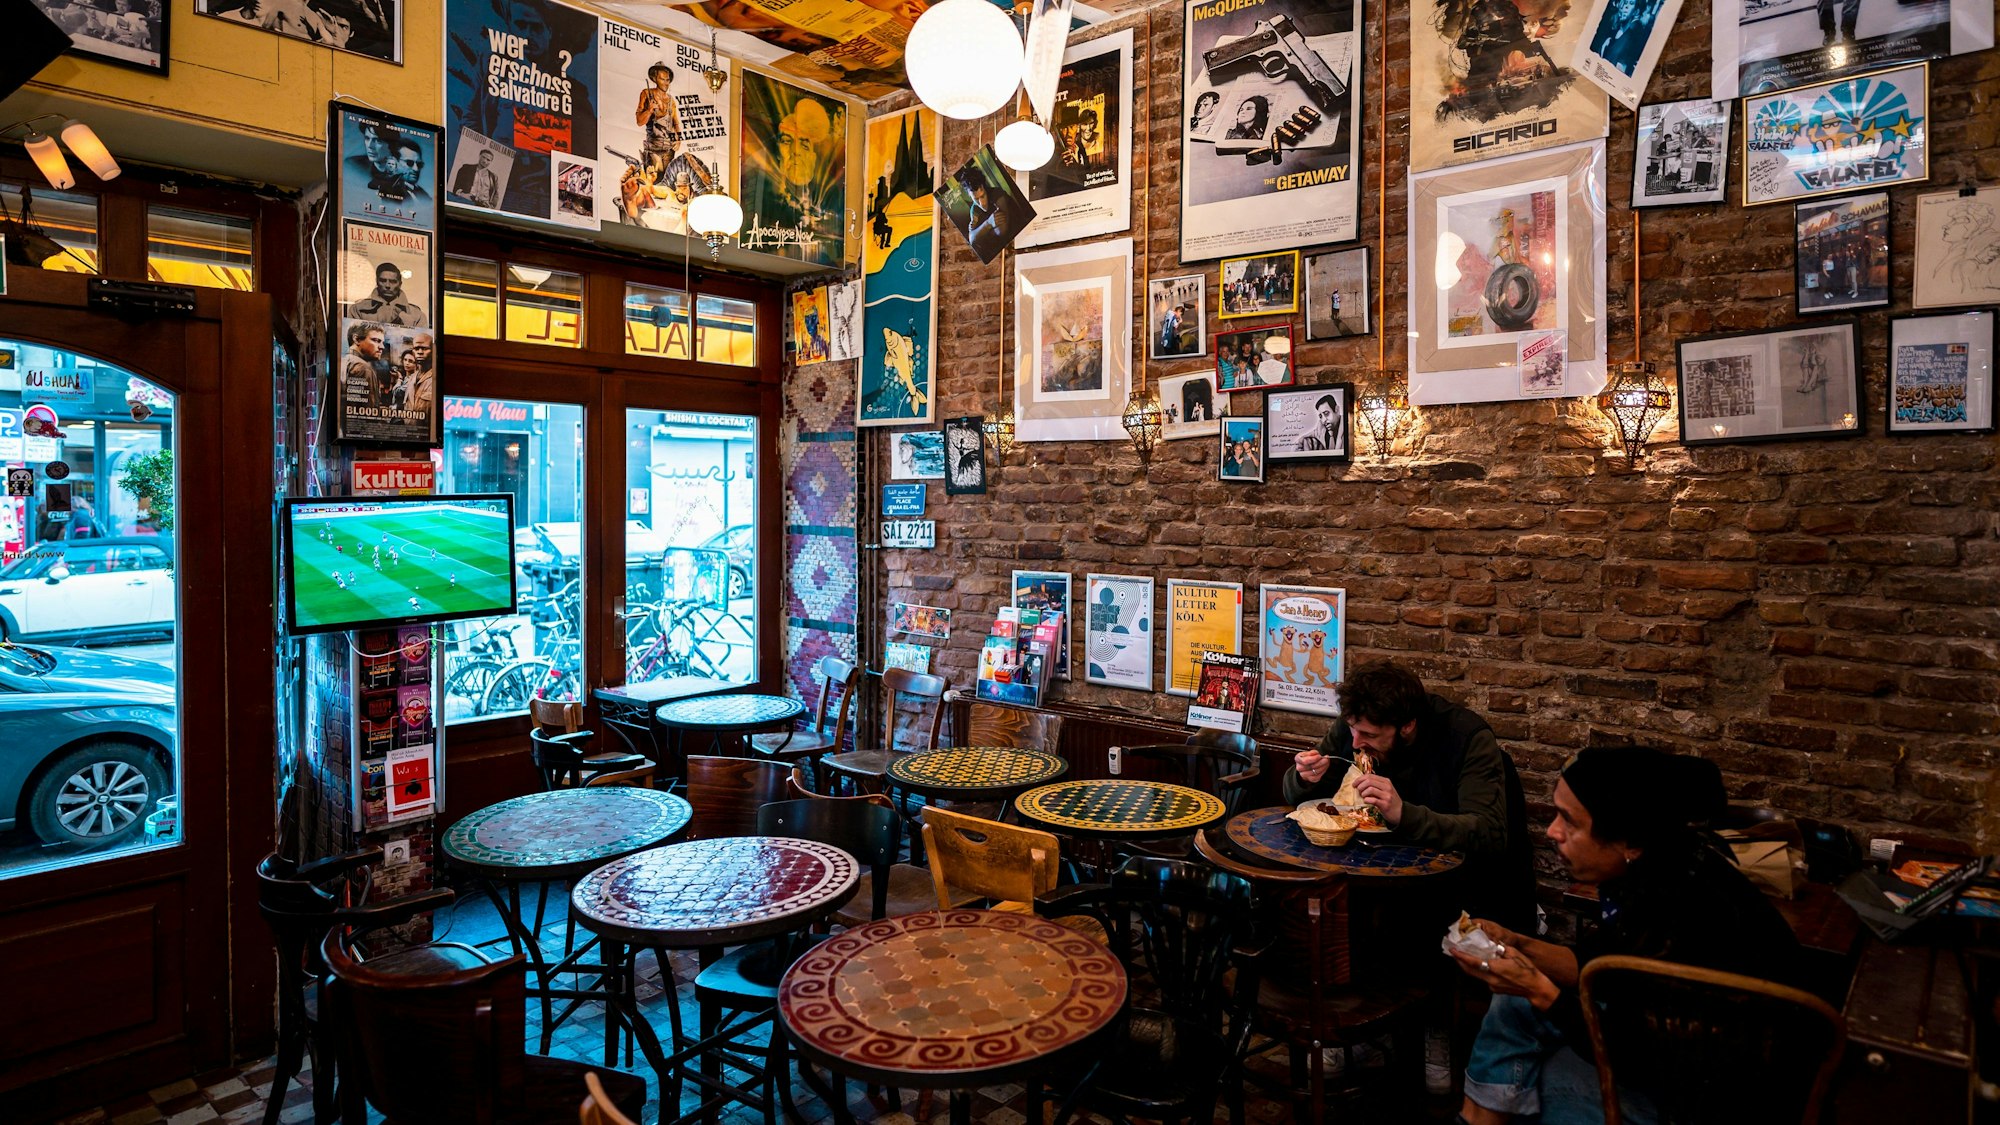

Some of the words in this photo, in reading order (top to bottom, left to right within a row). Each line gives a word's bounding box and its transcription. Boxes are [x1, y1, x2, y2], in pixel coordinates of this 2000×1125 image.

[604, 19, 661, 49] TERENCE
[488, 28, 528, 60] wer
[604, 35, 631, 52] HILL
[677, 44, 700, 60] BUD
[1886, 44, 1921, 57] SHEPHERD
[1782, 59, 1804, 70] FOSTER
[1896, 37, 1918, 47] KEITEL
[488, 74, 560, 112] Salvatore
[562, 94, 572, 115] G
[675, 94, 701, 106] VIER
[358, 118, 380, 127] PACINO
[386, 124, 408, 134] ROBERT
[410, 130, 431, 139] DENIRO
[681, 116, 704, 130] FÜR
[1454, 118, 1557, 154] SICARIO
[1264, 178, 1276, 186] THE
[1276, 164, 1349, 191] GETAWAY
[1803, 160, 1898, 187] FALAFEL
[364, 202, 417, 219] HEAT
[351, 227, 364, 242] LE
[746, 213, 795, 249] Apocalypse
[795, 220, 815, 248] Now
[1523, 336, 1554, 359] EXPIRED
[346, 405, 379, 417] BLOOD
[382, 408, 426, 420] DIAMOND
[488, 401, 527, 421] Haus
[666, 413, 698, 424] SHISHA
[699, 415, 706, 424] &
[708, 416, 748, 427] COCKTAIL
[355, 468, 433, 489] kultur
[907, 522, 933, 540] 2711
[1176, 587, 1218, 599] KULTUR
[1176, 599, 1217, 611] LETTER
[1280, 603, 1297, 616] Jan
[1302, 604, 1328, 622] Henry
[1176, 609, 1205, 623] KÖLN
[1201, 643, 1228, 652] KULTUR-
[1203, 650, 1245, 665] Kölner
[1294, 685, 1305, 693] Dez.
[1313, 688, 1326, 696] Köln
[1190, 711, 1213, 720] Kölner
